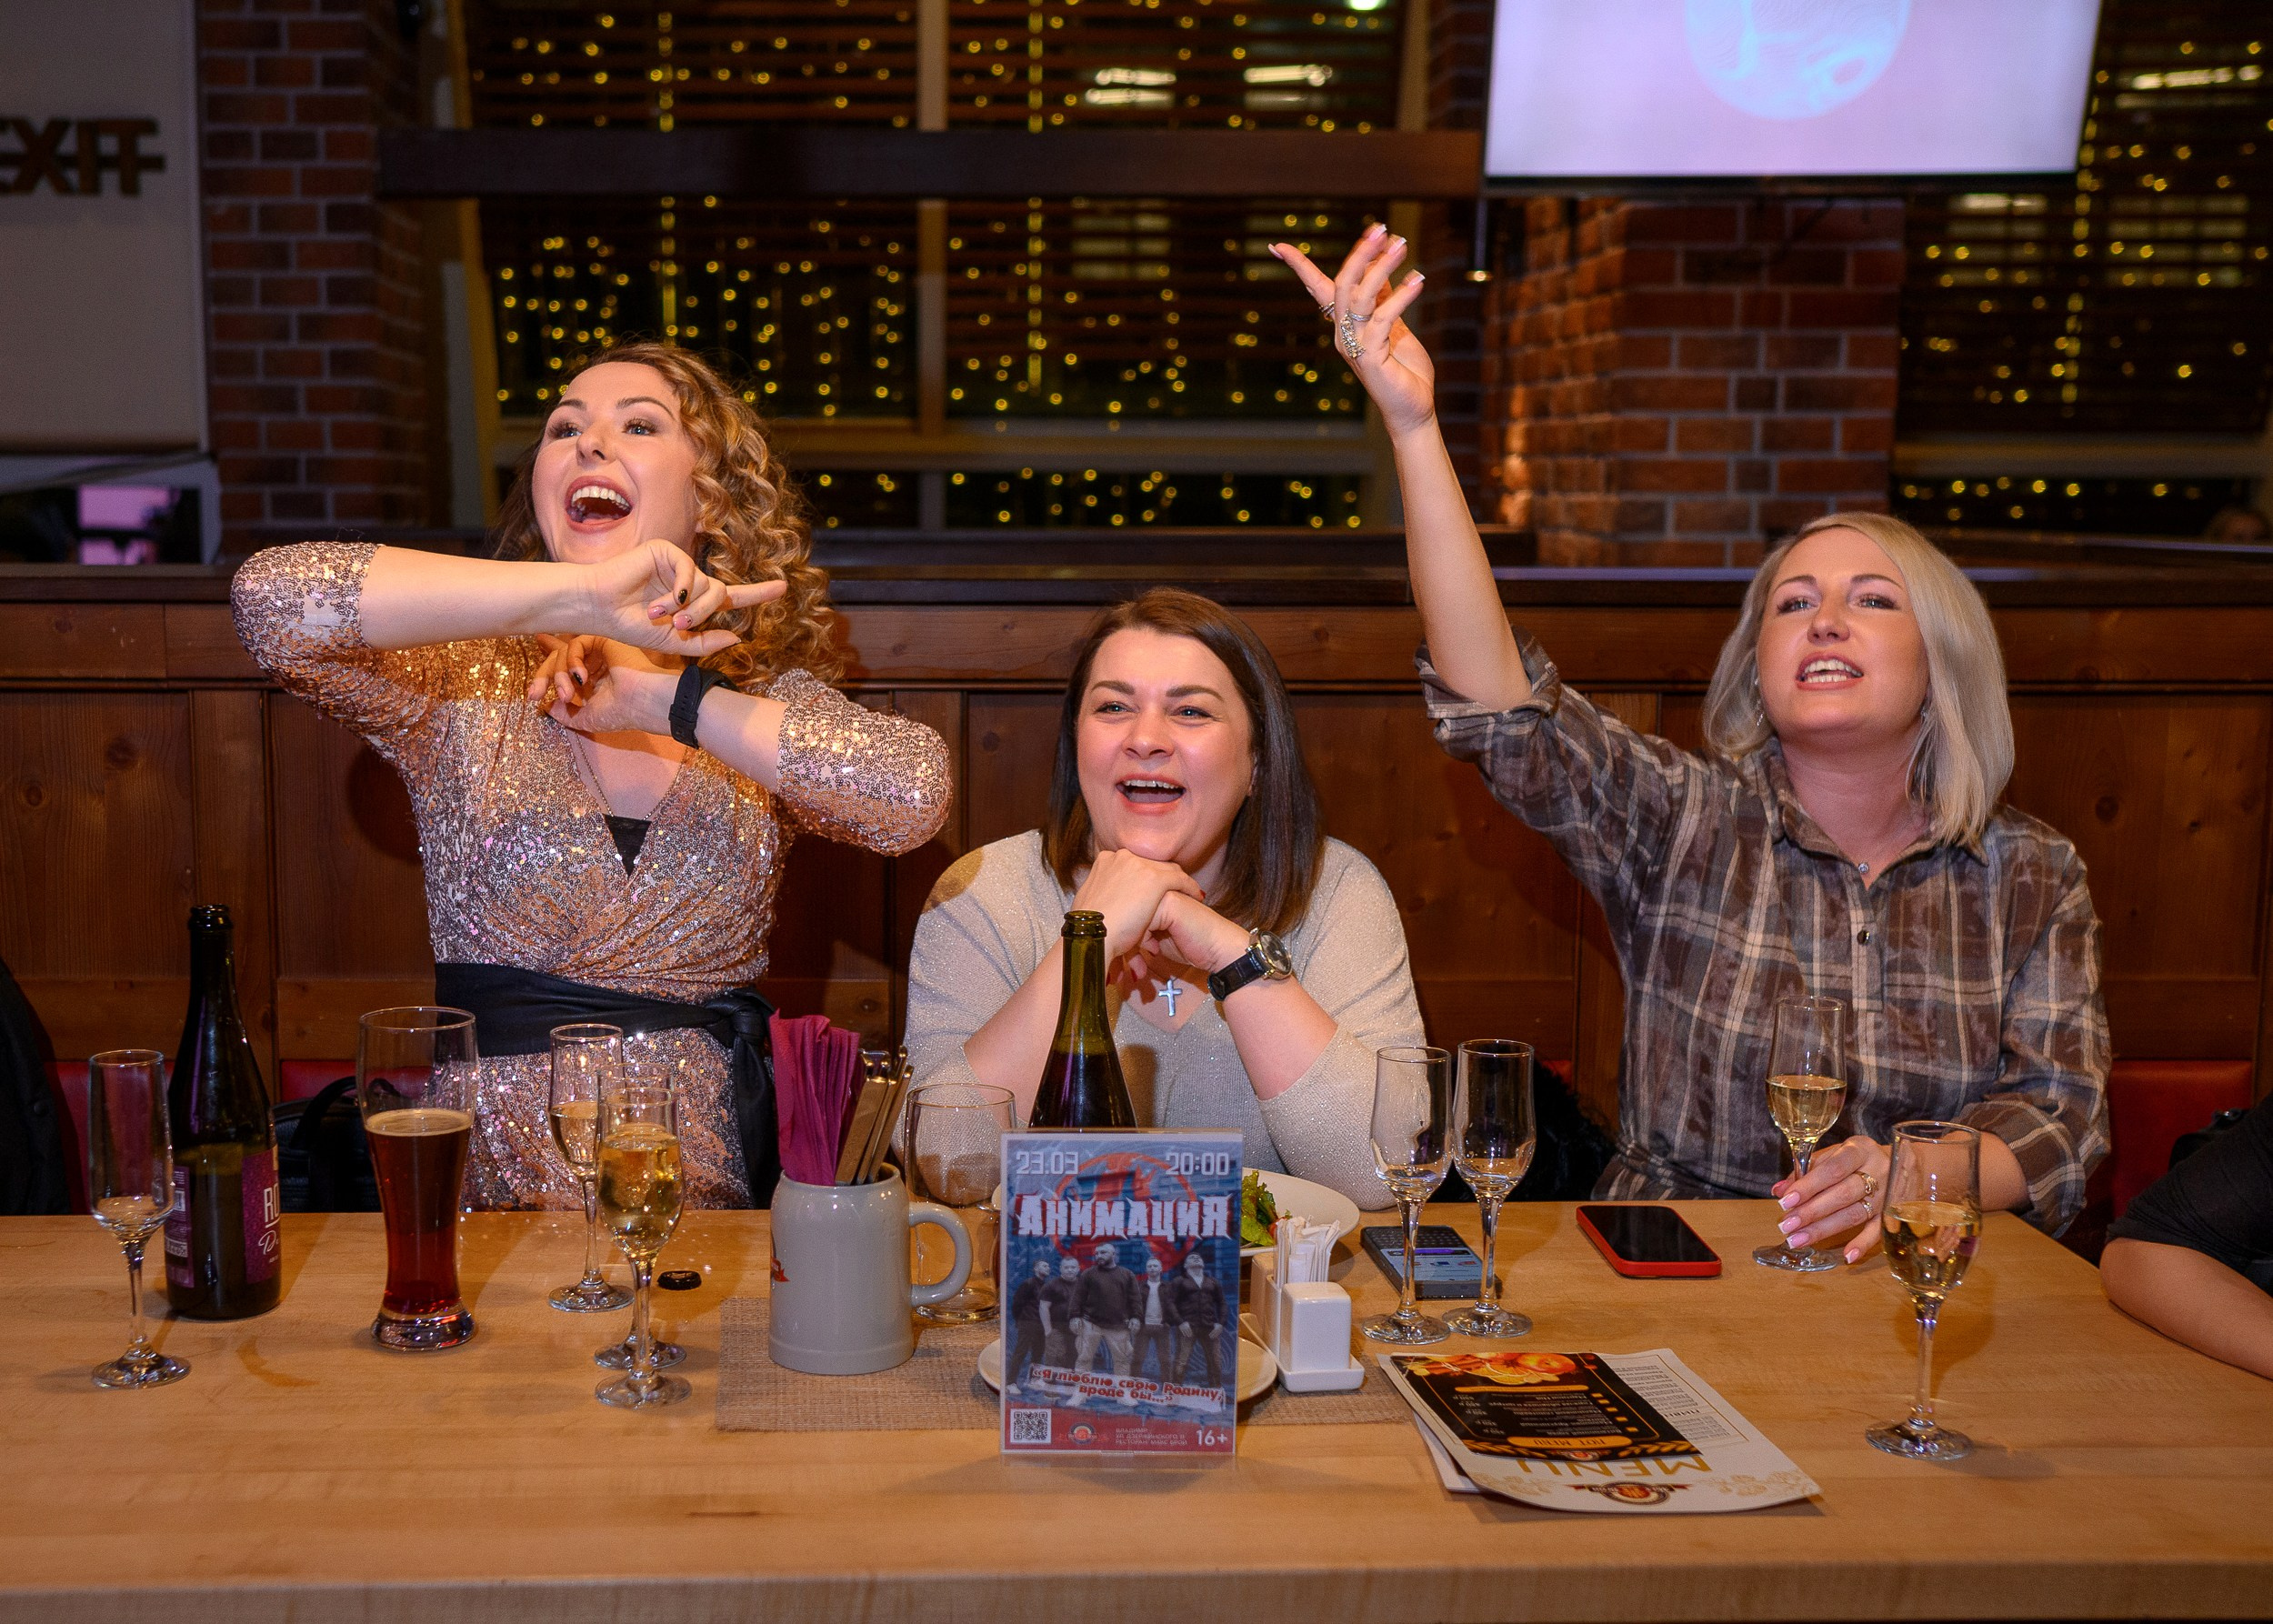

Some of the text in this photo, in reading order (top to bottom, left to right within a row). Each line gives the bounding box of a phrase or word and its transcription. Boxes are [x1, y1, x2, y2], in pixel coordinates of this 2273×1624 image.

[1016, 1151, 1079, 1175] 23.03
[1165, 1152, 1230, 1176] 20:00
[1014, 1192, 1234, 1242] АНИМАЦИЯ
[1056, 1371, 1114, 1388] люблю
[1118, 1378, 1159, 1393] свою
[1078, 1384, 1125, 1398] вроде
[1197, 1429, 1227, 1446] 16+
